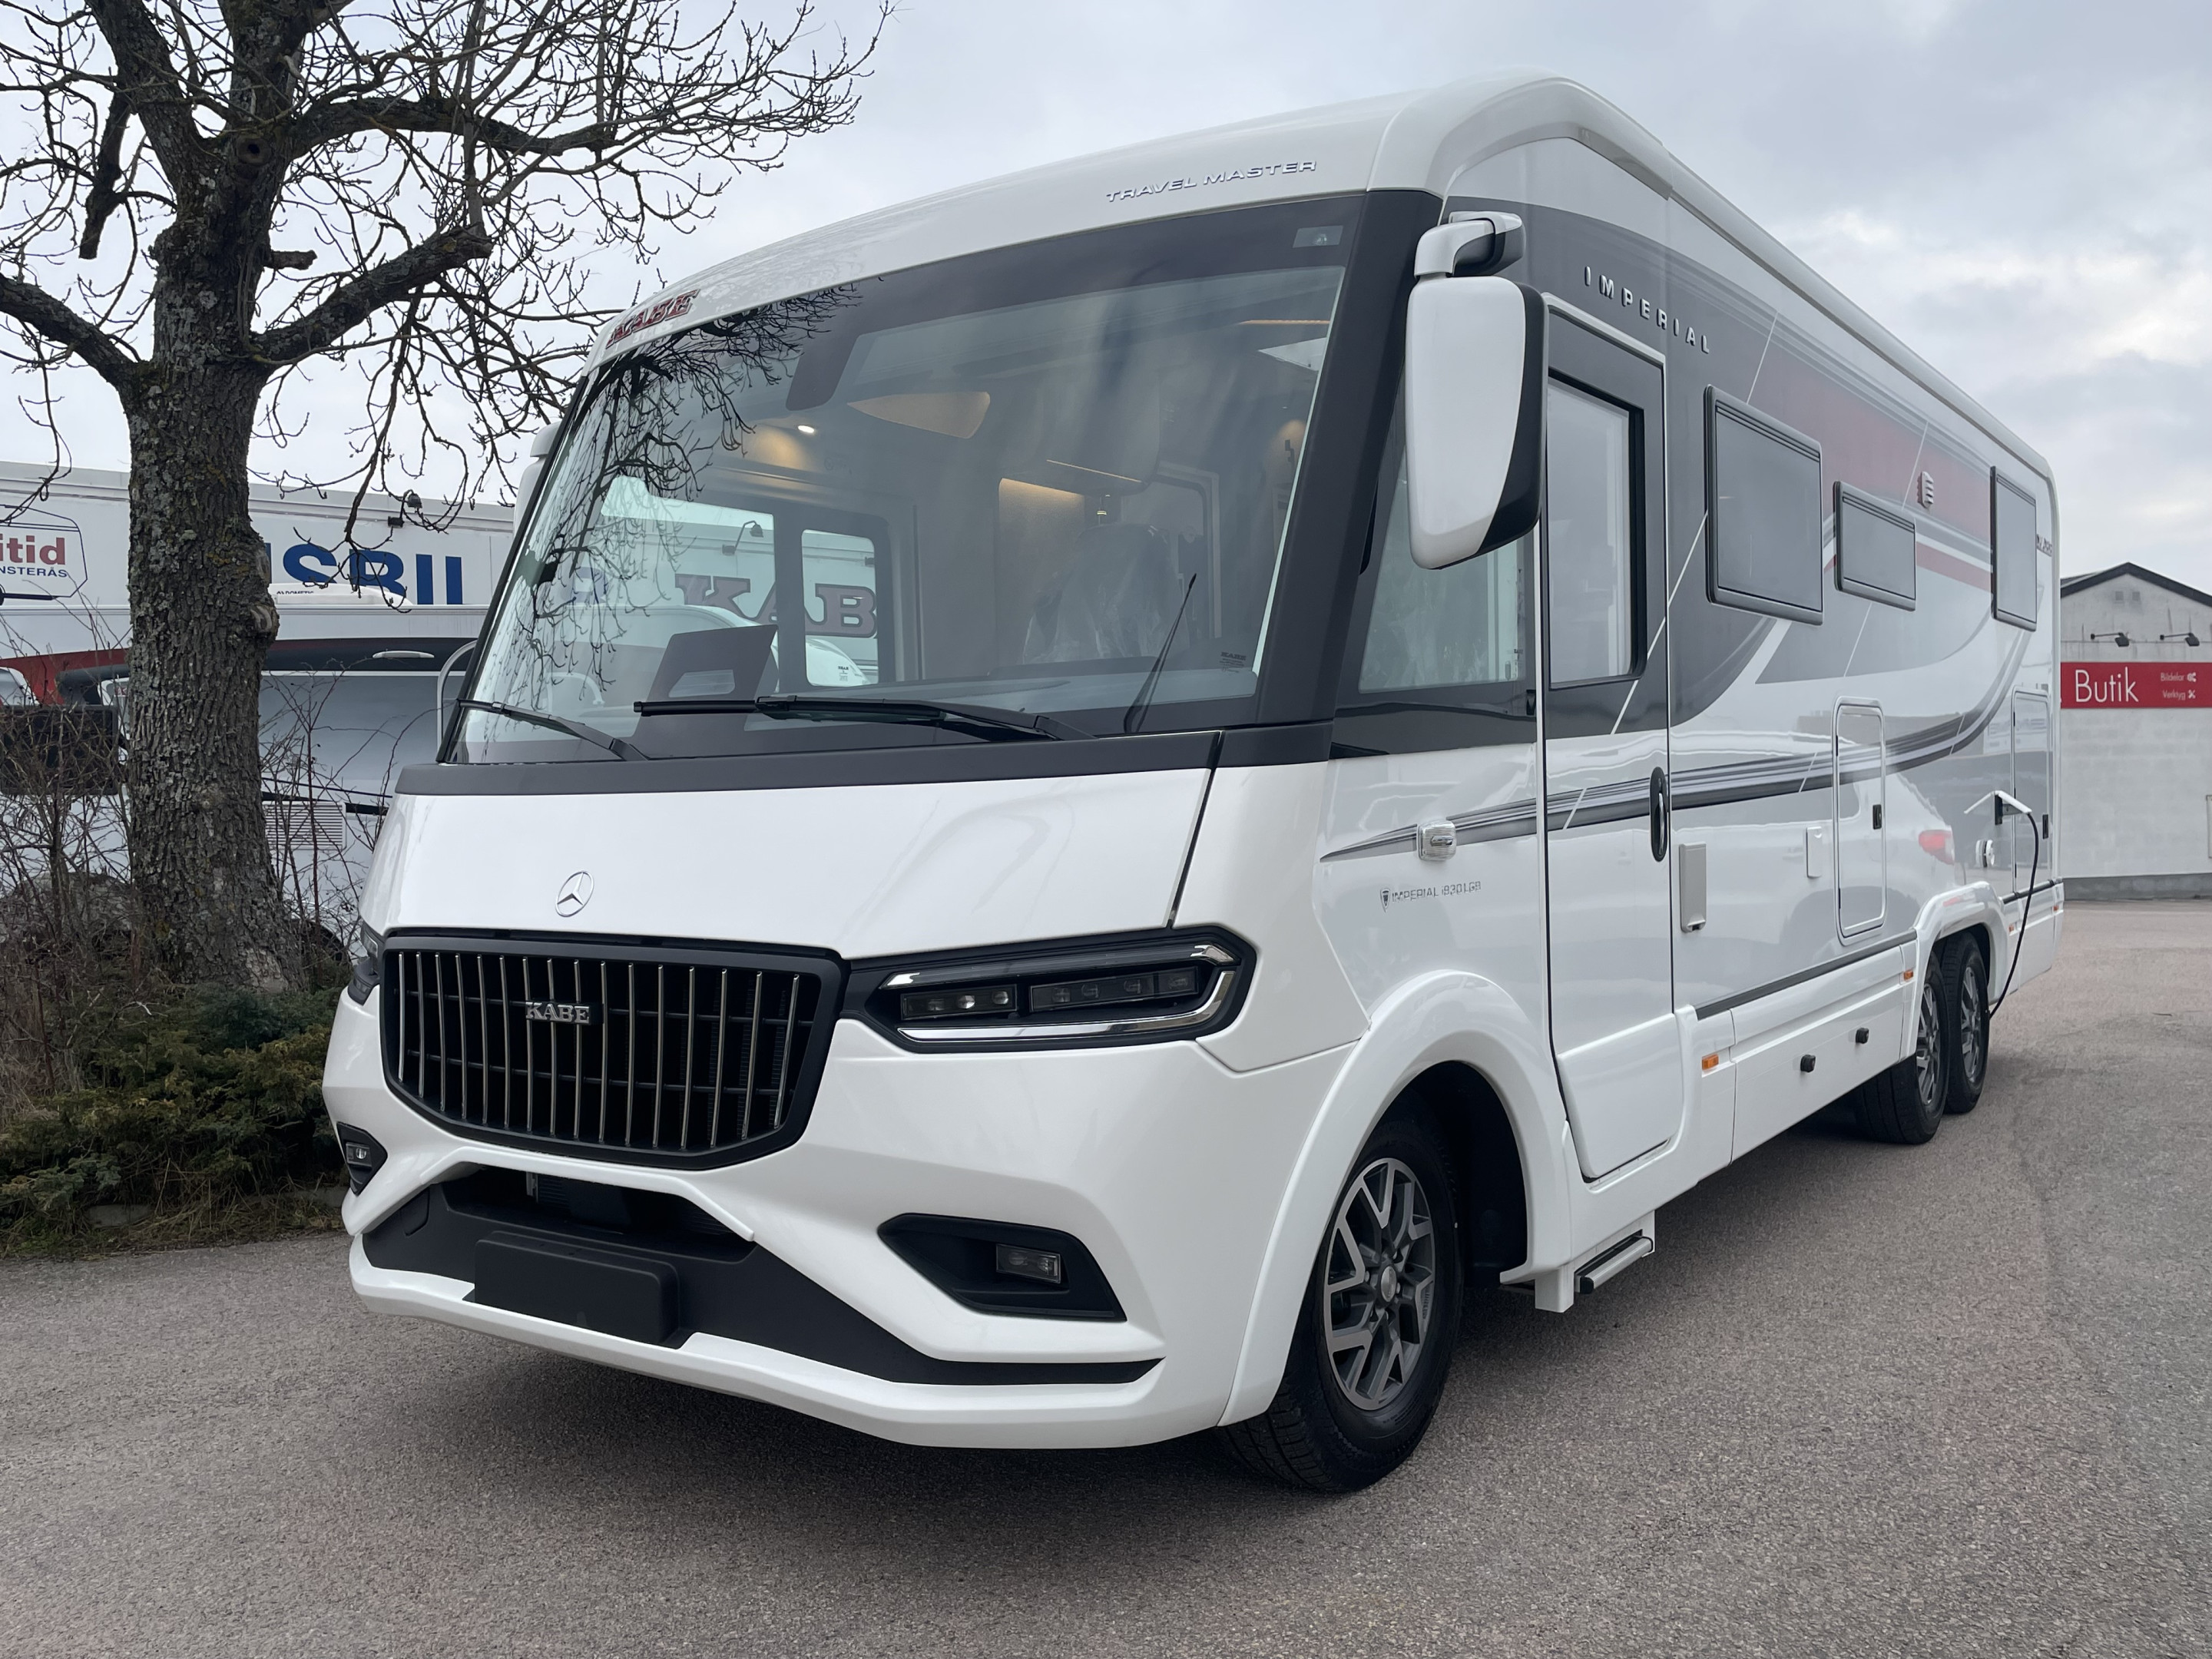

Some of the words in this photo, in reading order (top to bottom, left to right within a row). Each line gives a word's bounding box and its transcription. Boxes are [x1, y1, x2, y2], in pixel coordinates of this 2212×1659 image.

[1106, 177, 1197, 202] TRAVEL
[1203, 161, 1317, 187] MASTER
[605, 288, 701, 350] KABE
[1584, 266, 1710, 355] IMPERIAL
[2075, 666, 2139, 703] Butik
[1392, 887, 1439, 902] IMPERIAL
[525, 1002, 590, 1025] KABE
